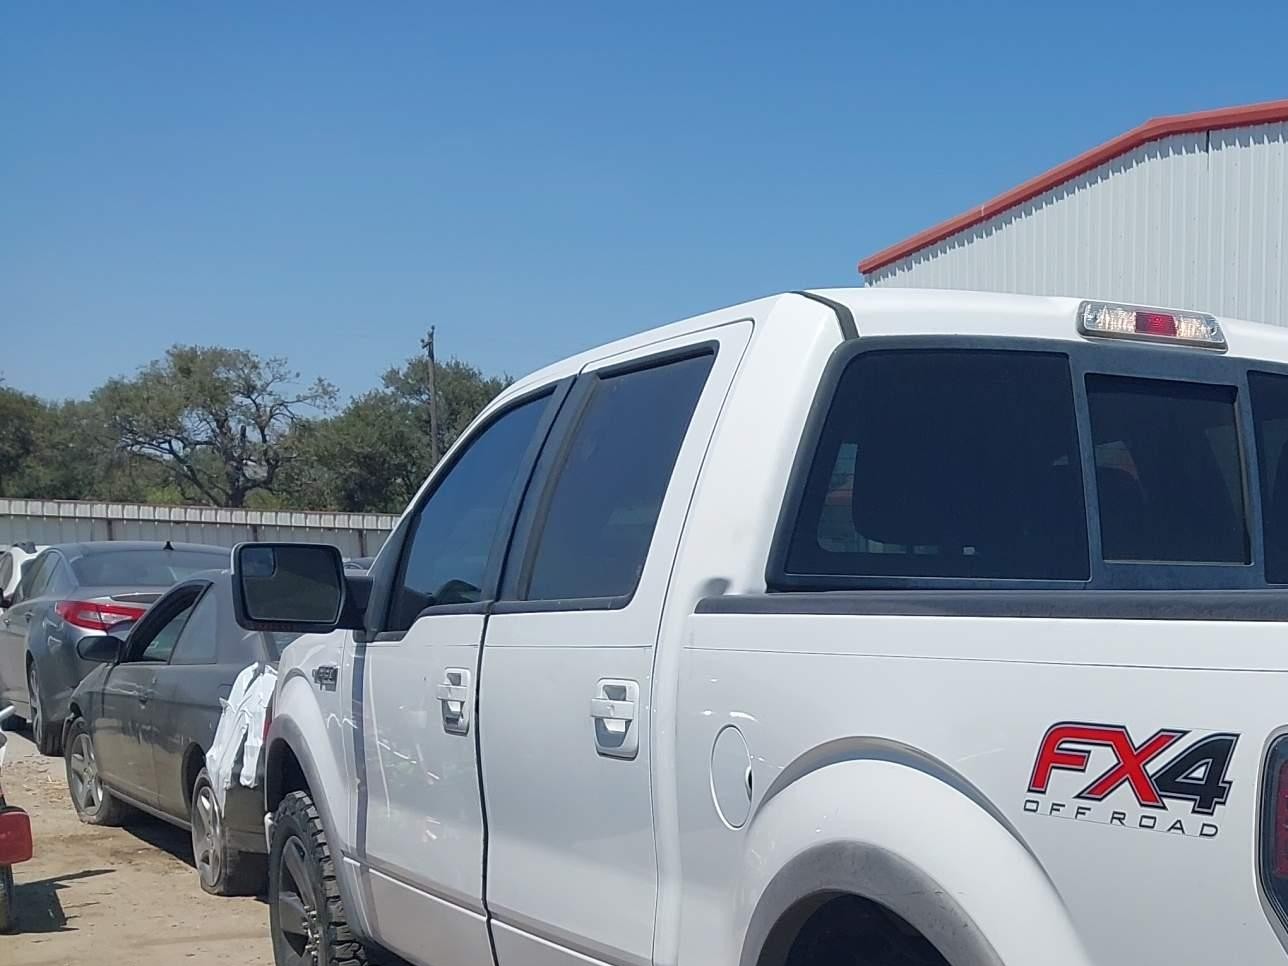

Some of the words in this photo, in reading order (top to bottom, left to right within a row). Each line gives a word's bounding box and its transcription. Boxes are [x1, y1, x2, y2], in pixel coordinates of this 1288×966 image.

[1026, 721, 1241, 816] FX4
[1023, 800, 1091, 819] OFF
[1110, 811, 1219, 838] ROAD
